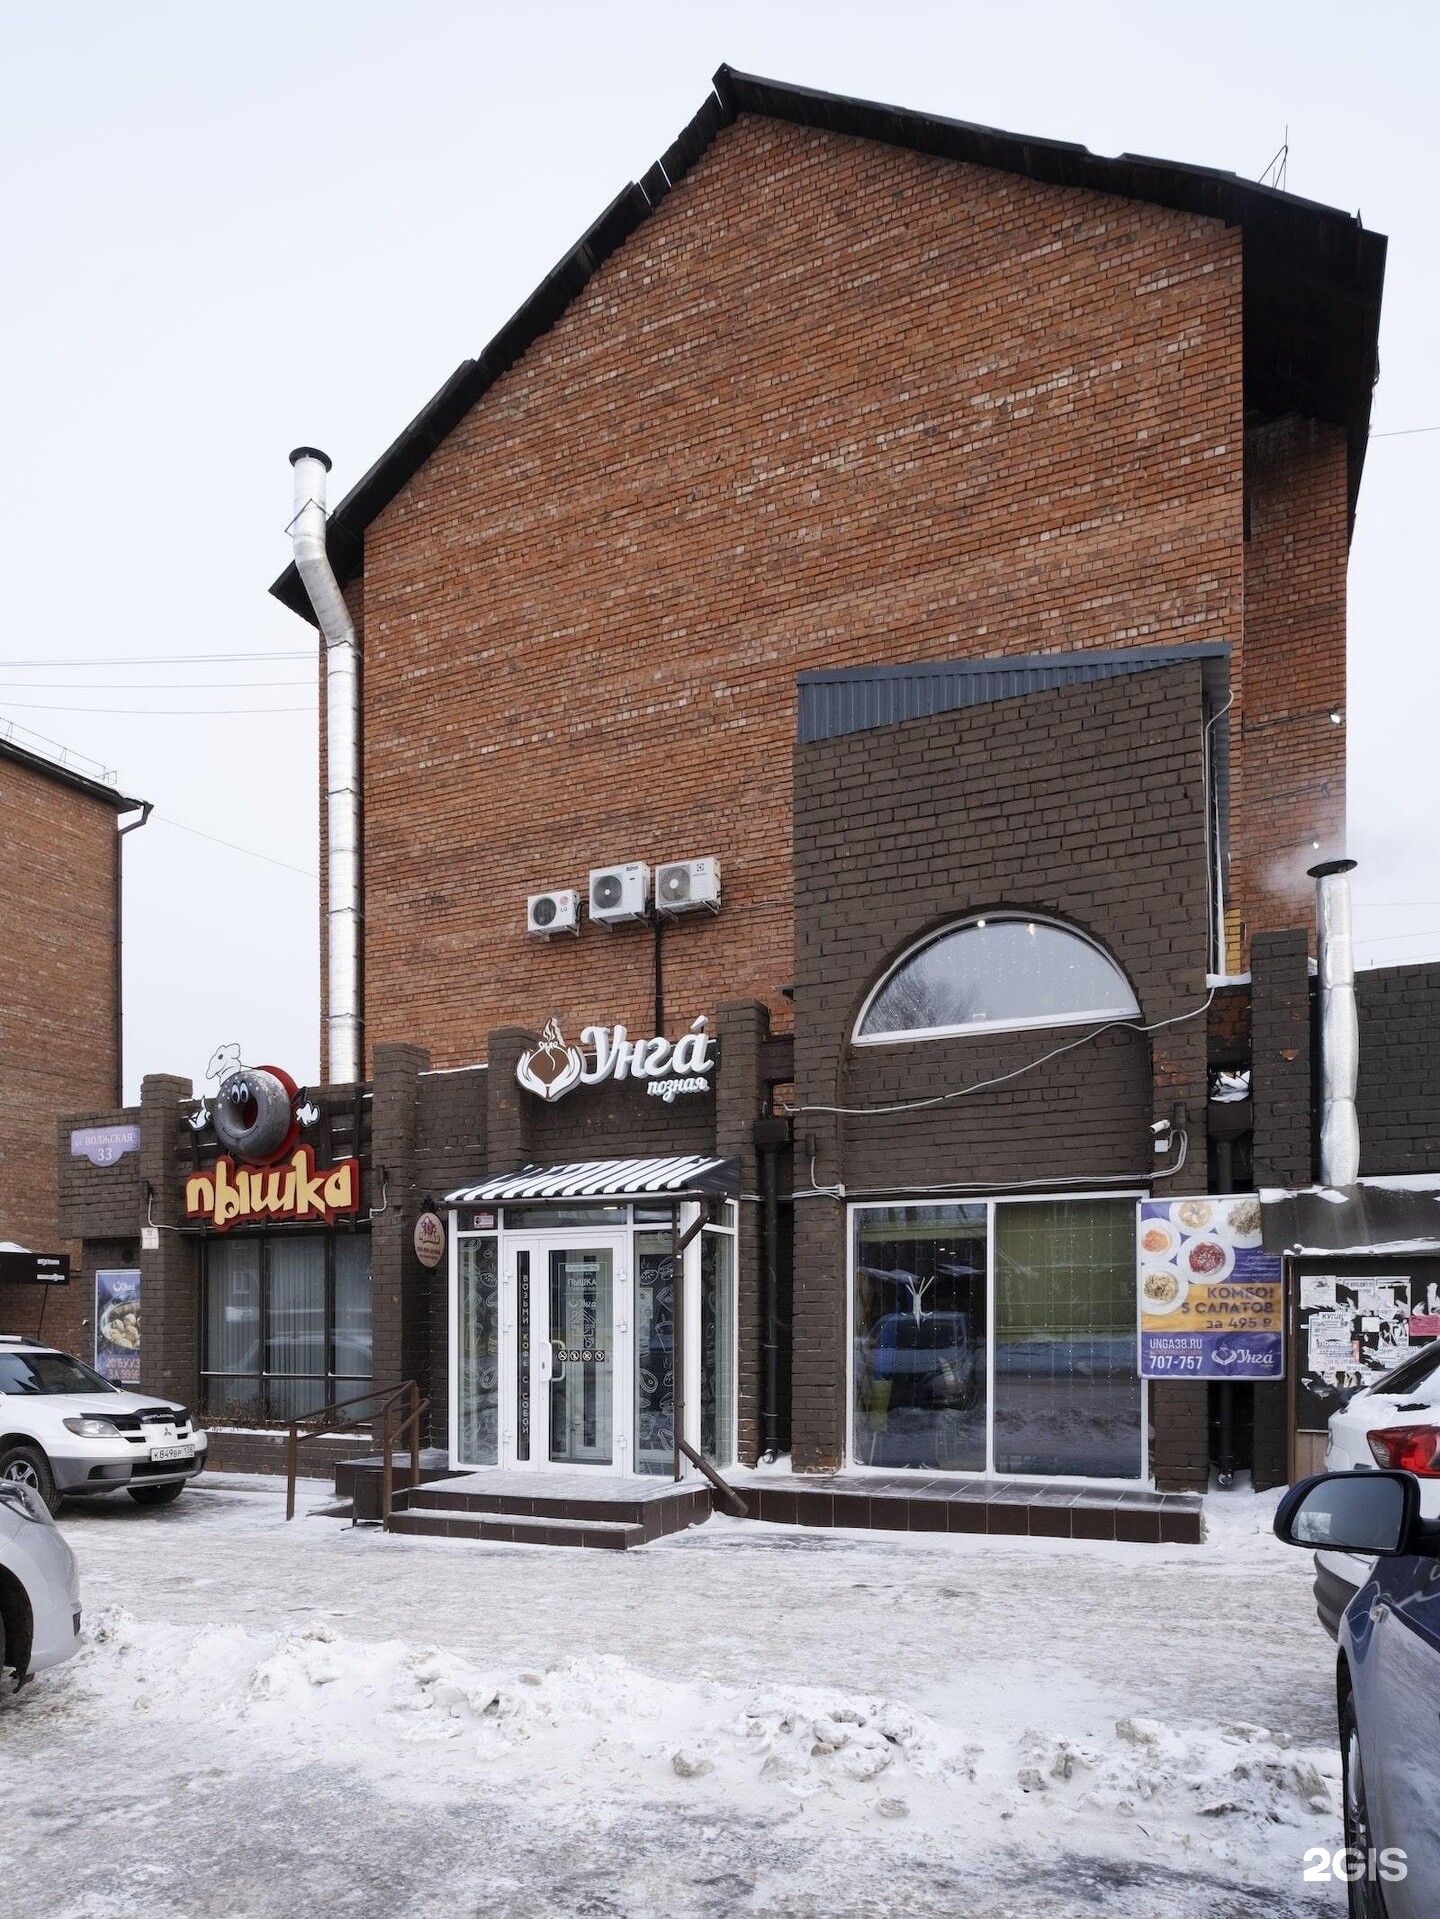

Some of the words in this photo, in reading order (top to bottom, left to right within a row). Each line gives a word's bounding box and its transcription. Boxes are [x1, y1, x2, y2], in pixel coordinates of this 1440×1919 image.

[647, 1077, 710, 1103] позная
[85, 1133, 133, 1145] ВОЛЖСКАЯ
[98, 1148, 112, 1161] 33
[1181, 1303, 1190, 1313] 5
[1195, 1302, 1274, 1313] САЛАТОВ
[1229, 1318, 1257, 1329] 495
[1150, 1339, 1203, 1349] UNGA38.RU
[1150, 1356, 1203, 1369] 707-757
